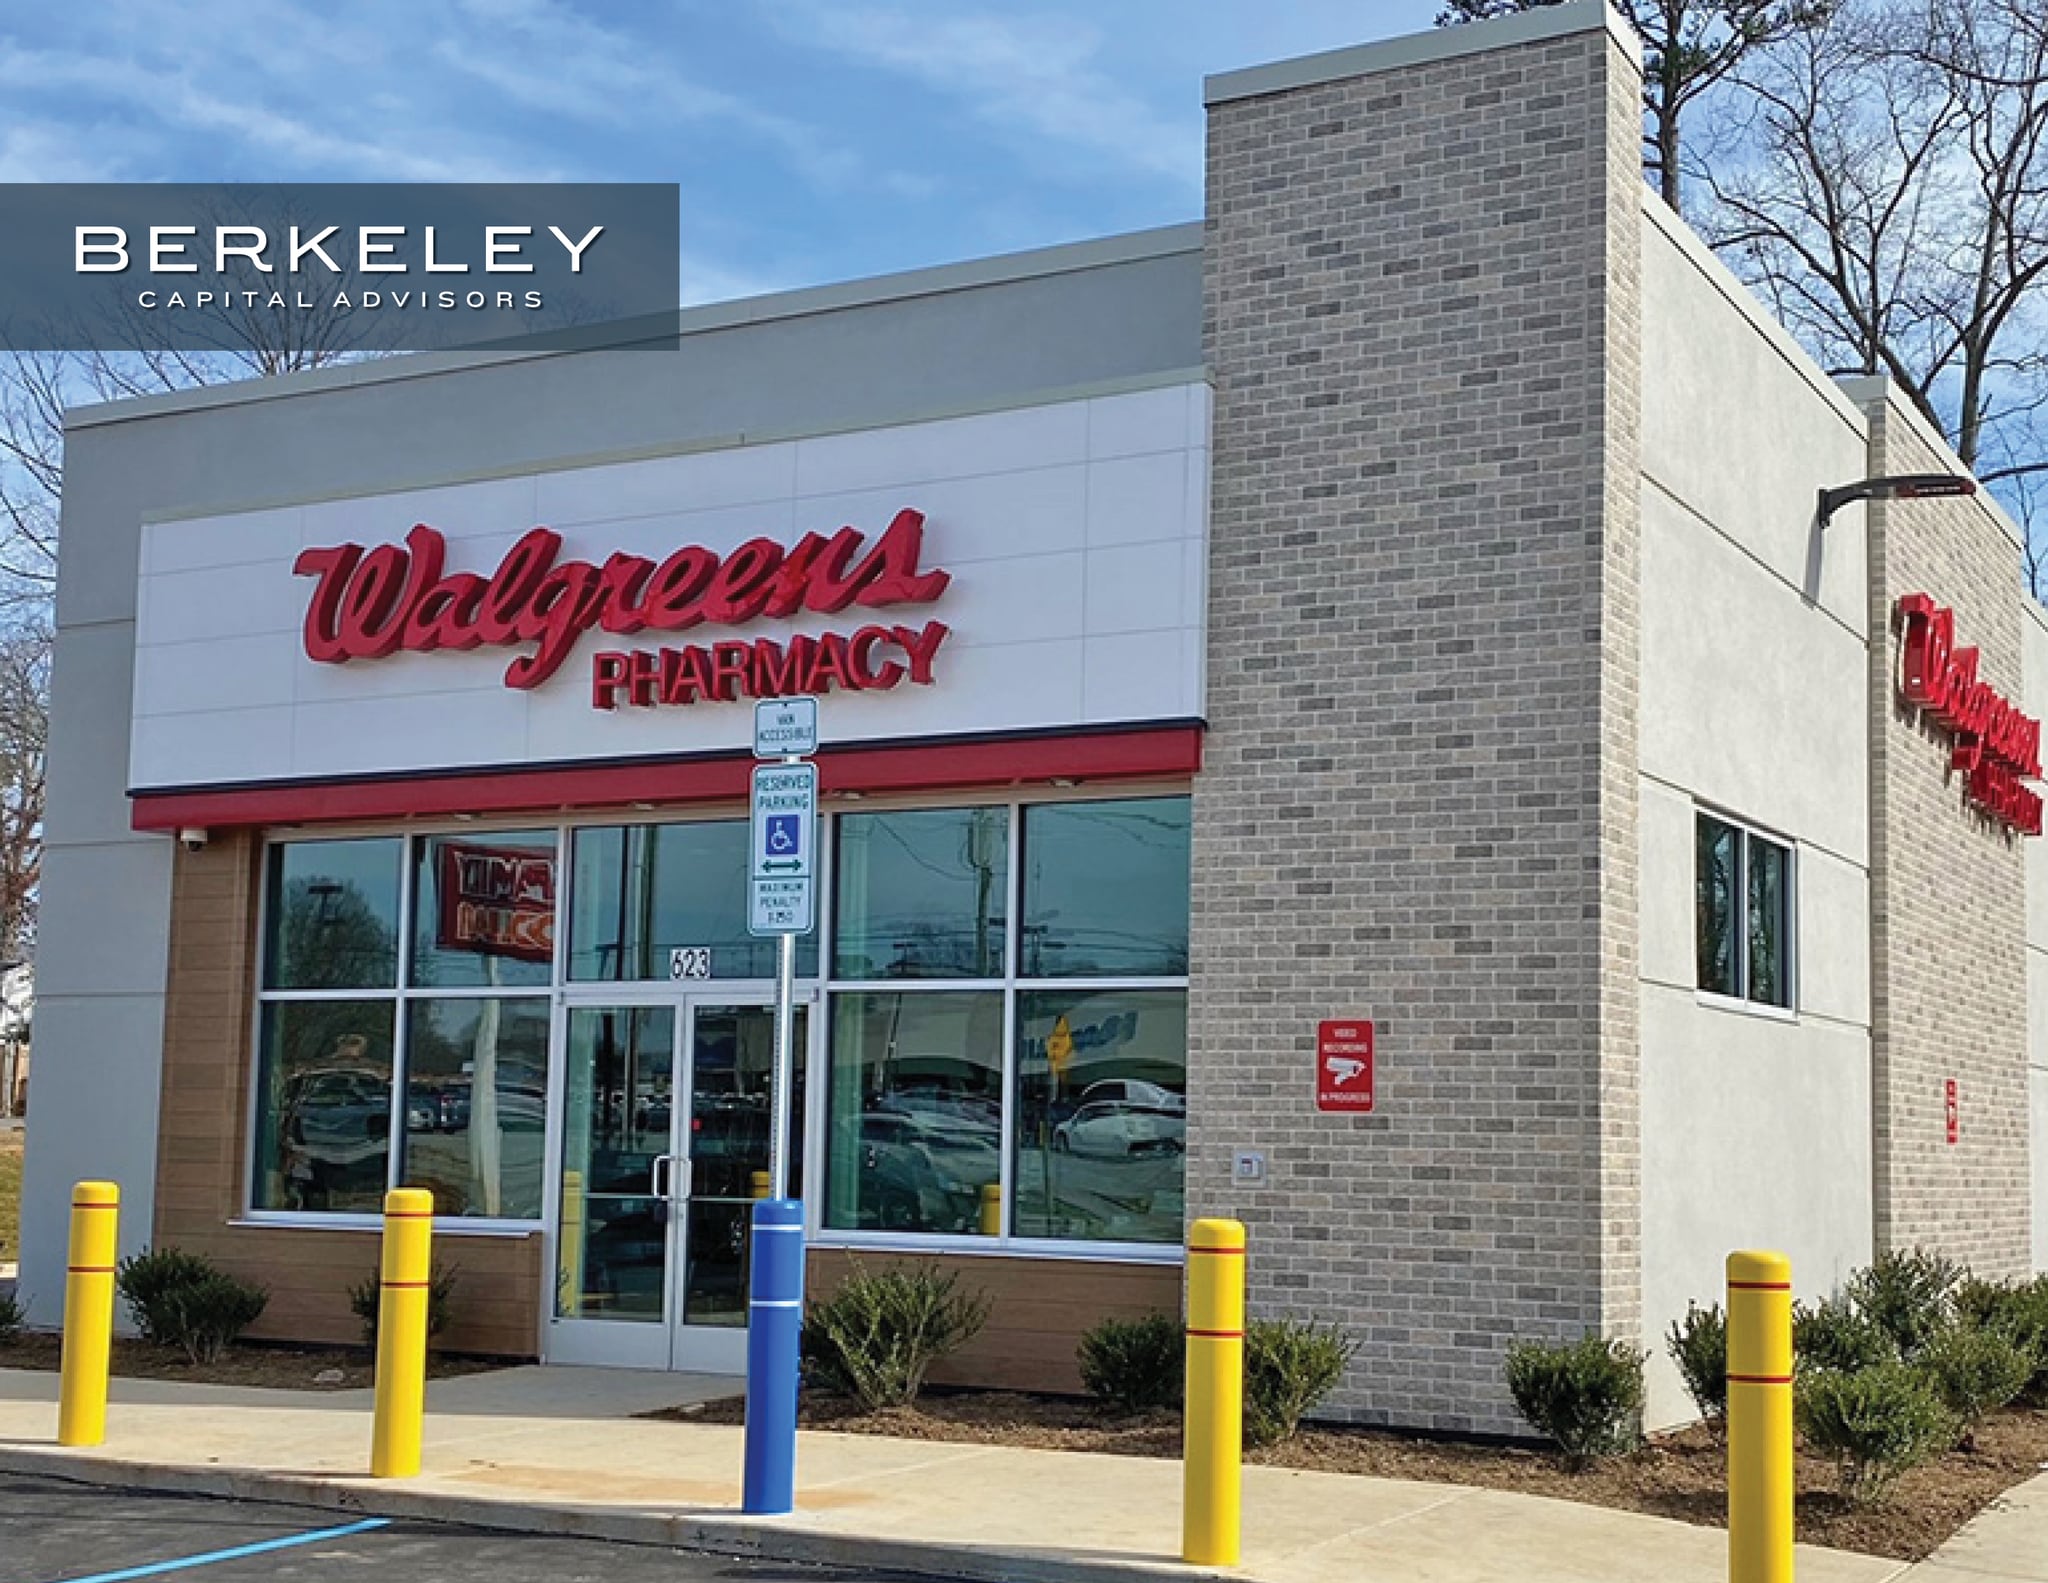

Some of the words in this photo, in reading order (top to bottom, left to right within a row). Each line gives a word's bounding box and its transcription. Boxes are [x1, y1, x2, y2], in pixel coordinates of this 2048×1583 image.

[293, 507, 951, 691] Walgreens
[592, 621, 949, 710] PHARMACY
[759, 727, 812, 742] ACCESSIBLE
[757, 774, 811, 792] RESERVED
[759, 792, 809, 810] PARKING
[759, 882, 804, 893] MAXIMUM
[759, 896, 802, 908] PENALTY
[672, 949, 709, 979] 623
